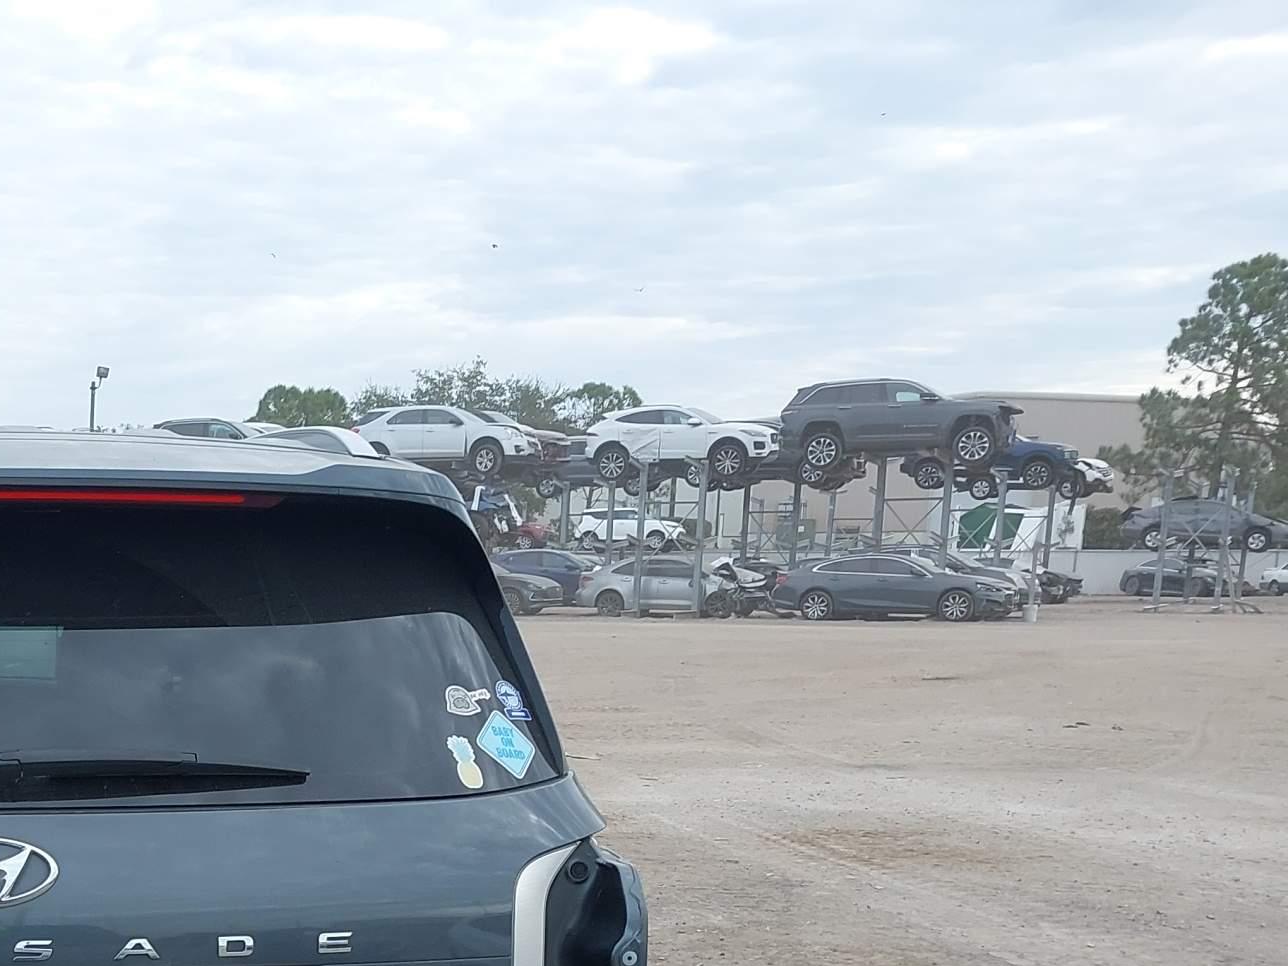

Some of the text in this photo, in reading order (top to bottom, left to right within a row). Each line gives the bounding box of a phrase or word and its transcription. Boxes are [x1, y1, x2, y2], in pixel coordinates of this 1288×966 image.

[492, 726, 514, 738] BABY
[501, 737, 515, 748] ON
[496, 747, 526, 759] BOARD
